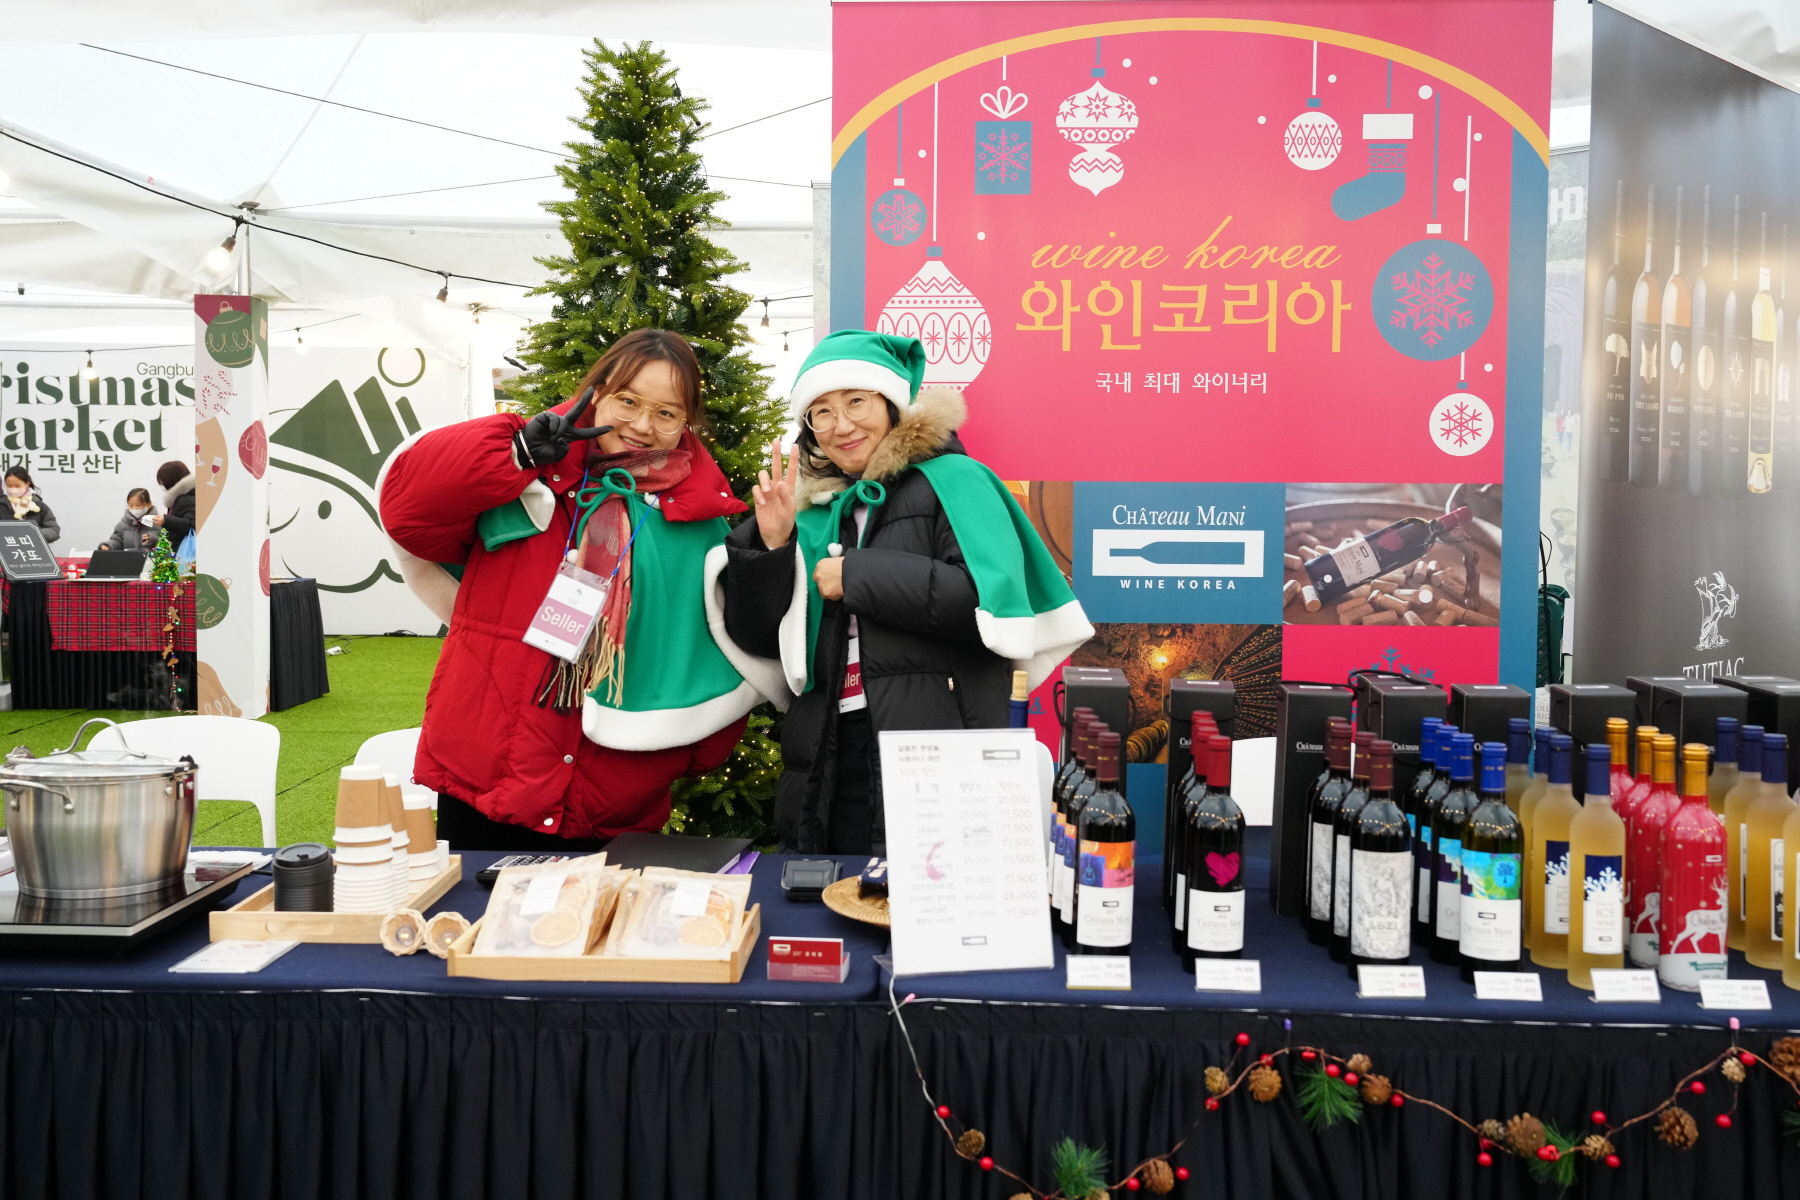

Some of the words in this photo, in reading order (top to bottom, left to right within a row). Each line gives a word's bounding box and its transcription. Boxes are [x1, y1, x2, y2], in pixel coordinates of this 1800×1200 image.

[1031, 231, 1169, 269] wine
[1183, 215, 1342, 269] korea
[1015, 279, 1352, 352] 와인코리아
[136, 362, 194, 379] Gangbu
[1095, 372, 1132, 393] 국내
[1143, 372, 1180, 394] 최대
[1192, 372, 1268, 394] 와이너리
[37, 453, 75, 474] 그린
[82, 453, 121, 474] 산타
[4, 534, 35, 548] 쁘띠
[11, 548, 43, 562] 갸또
[1120, 579, 1165, 589] WINE
[1177, 580, 1236, 590] KOREA
[541, 606, 585, 635] Seller
[998, 795, 1031, 805] 21,000
[1000, 809, 1032, 819] 17,500
[1001, 824, 1033, 834] 17,500
[1002, 838, 1034, 848] 17,500
[1003, 855, 1035, 865] 17,500
[1005, 874, 1037, 884] 17,500
[1003, 891, 1038, 901] 28,000
[1007, 908, 1039, 918] 17,500
[1596, 908, 1615, 918] ICE
